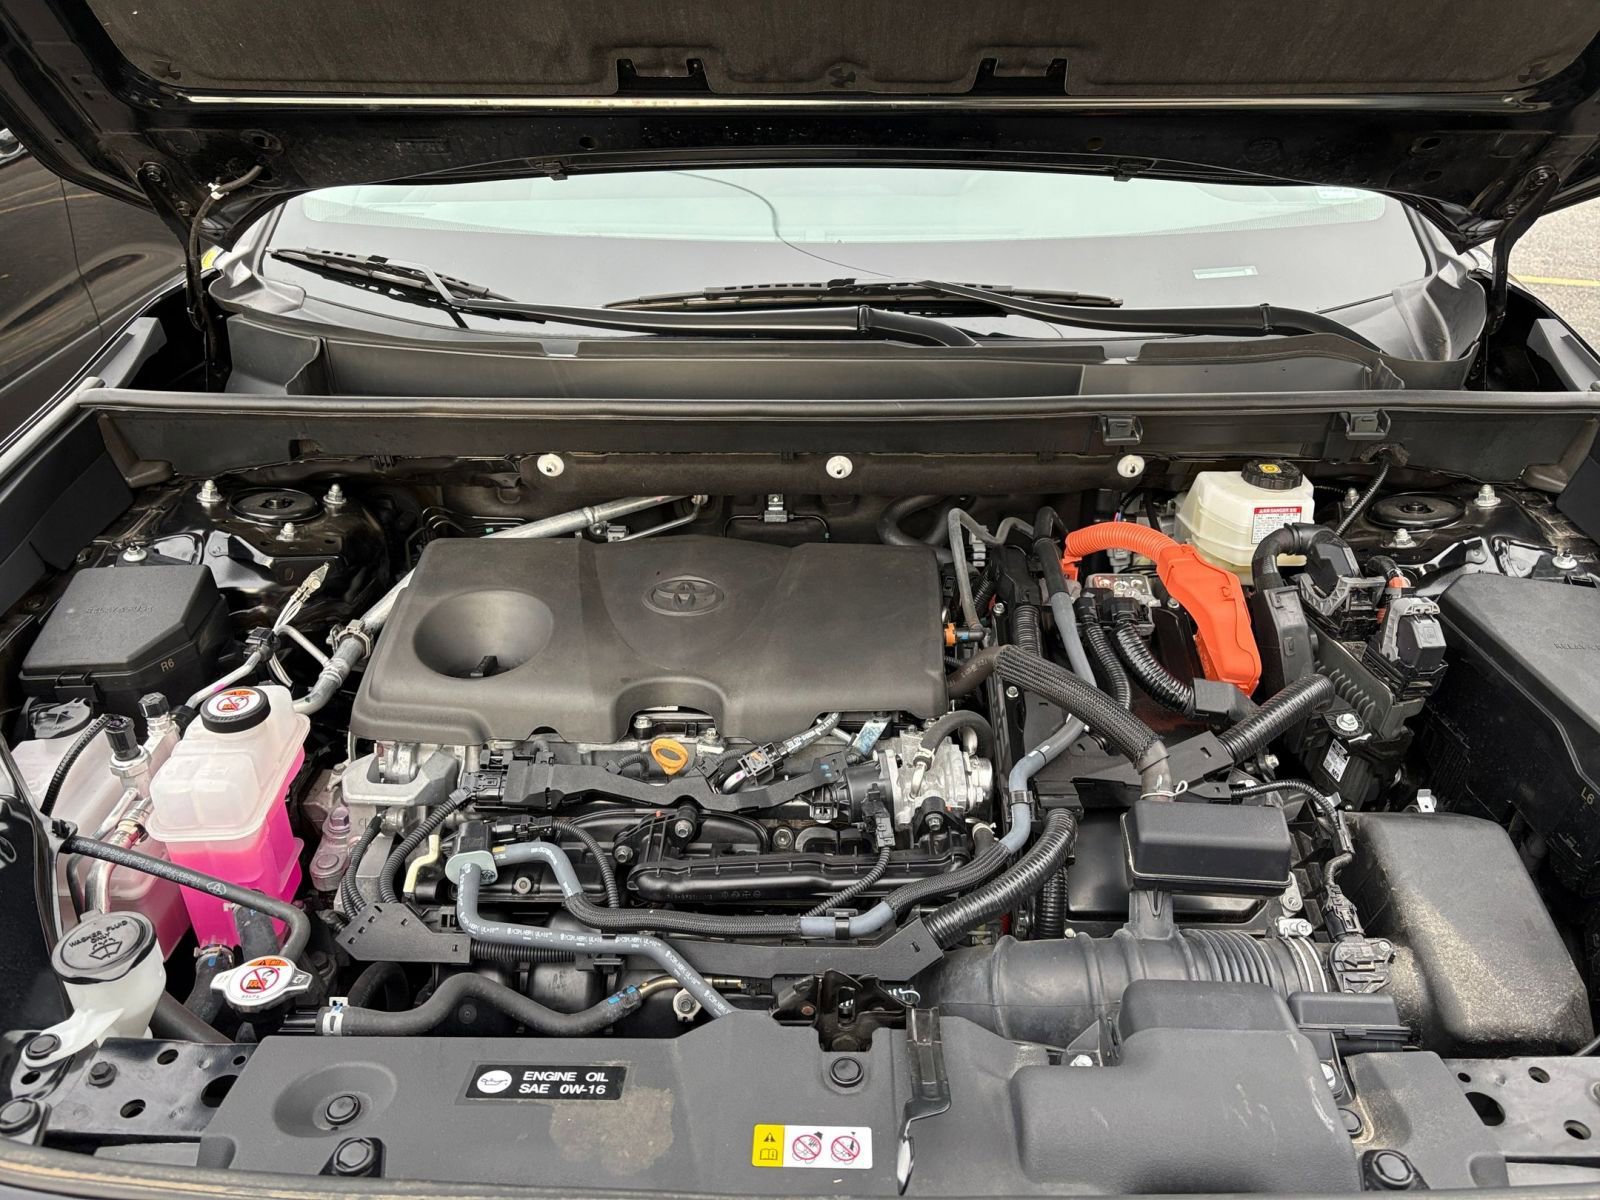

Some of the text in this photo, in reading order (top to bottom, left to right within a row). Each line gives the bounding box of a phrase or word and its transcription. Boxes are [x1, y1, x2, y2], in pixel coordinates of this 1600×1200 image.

[160, 658, 176, 673] R6
[1581, 786, 1595, 805] L6
[69, 920, 128, 948] WASHER FLUID
[91, 931, 111, 944] ONLY
[522, 1071, 609, 1082] ENGINE OIL
[518, 1084, 606, 1095] SAE 0W-16
